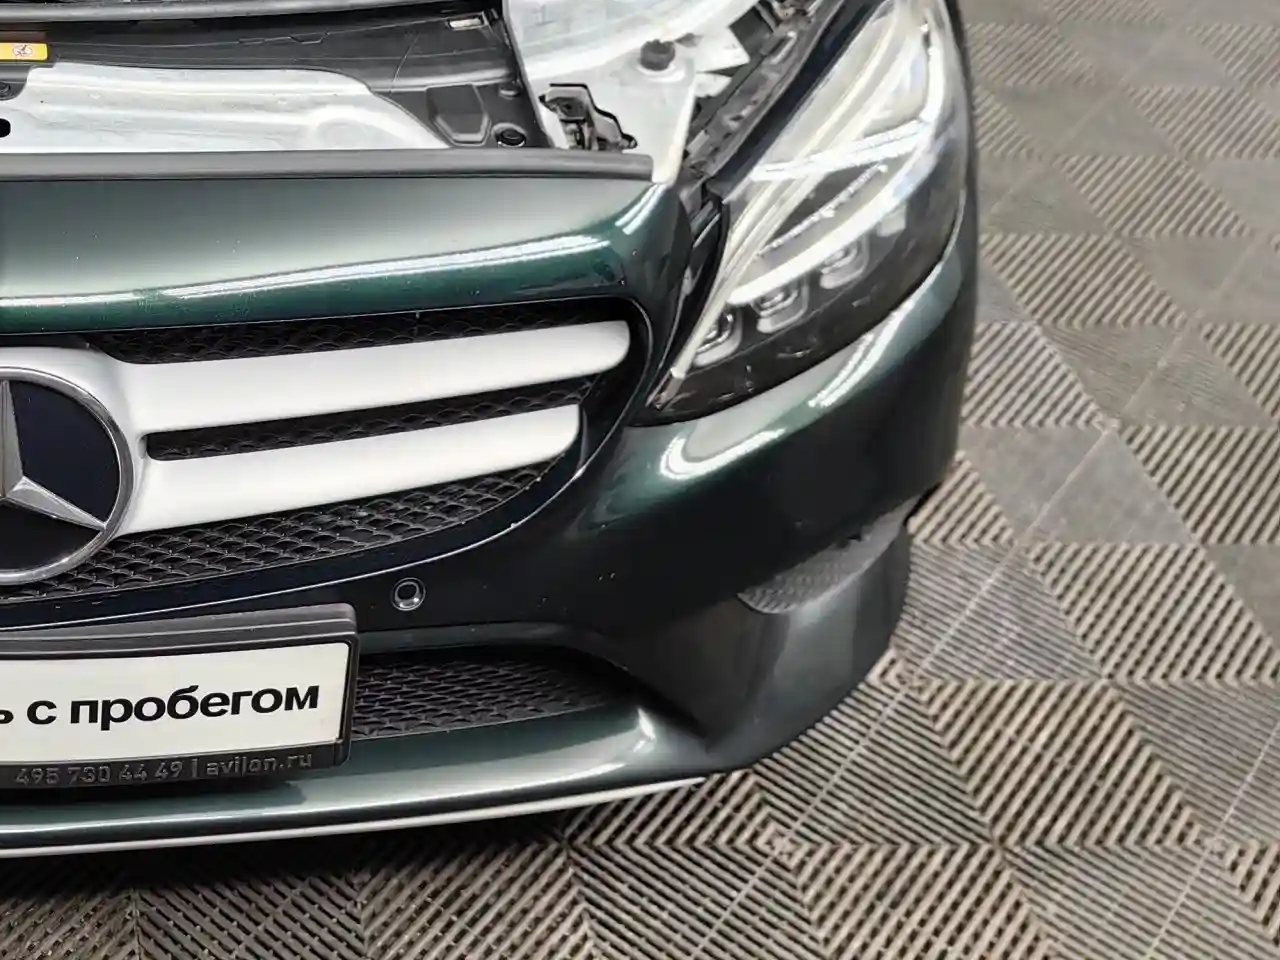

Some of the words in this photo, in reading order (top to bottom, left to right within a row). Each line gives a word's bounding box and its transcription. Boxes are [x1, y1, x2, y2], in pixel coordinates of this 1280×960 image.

[26, 700, 57, 725] с
[70, 684, 320, 731] пробегом
[14, 768, 60, 786] 495
[119, 763, 148, 782] 44
[153, 759, 182, 780] 49
[206, 751, 312, 775] avilon.ru
